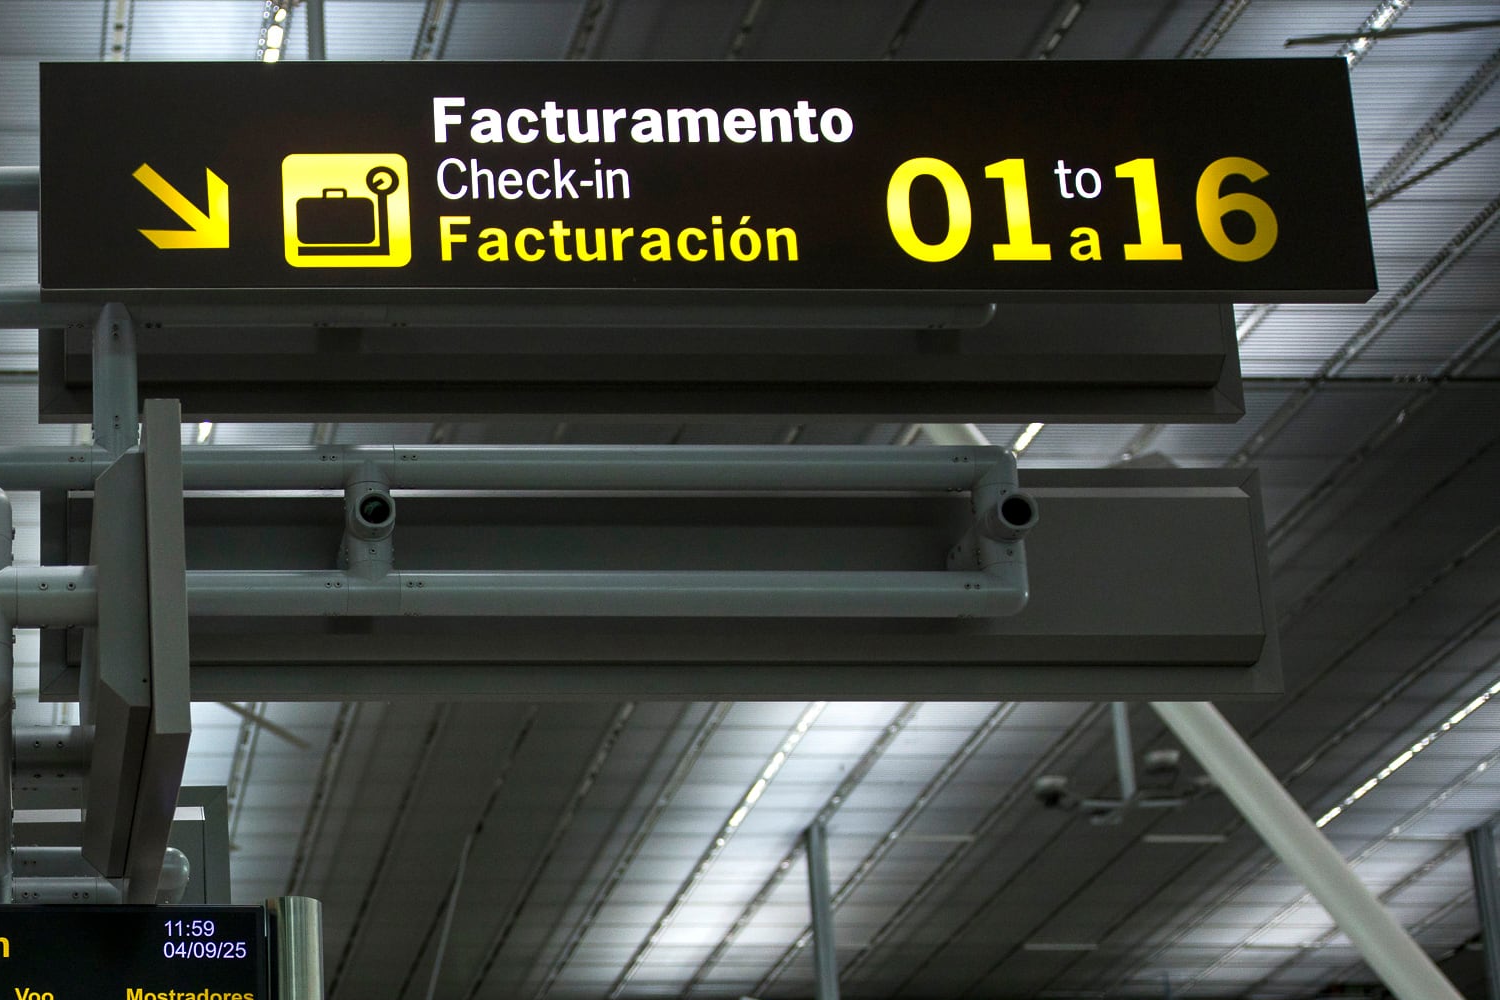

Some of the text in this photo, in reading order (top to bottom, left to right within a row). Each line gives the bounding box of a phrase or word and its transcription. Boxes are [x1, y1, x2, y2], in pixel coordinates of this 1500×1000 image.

[433, 97, 854, 144] Facturamento
[436, 157, 630, 200] Check-in
[886, 156, 1278, 263] 01 to 16
[439, 215, 799, 262] Facturación
[1070, 226, 1102, 262] a
[163, 941, 247, 959] 04/09/25
[164, 920, 215, 937] 11:59
